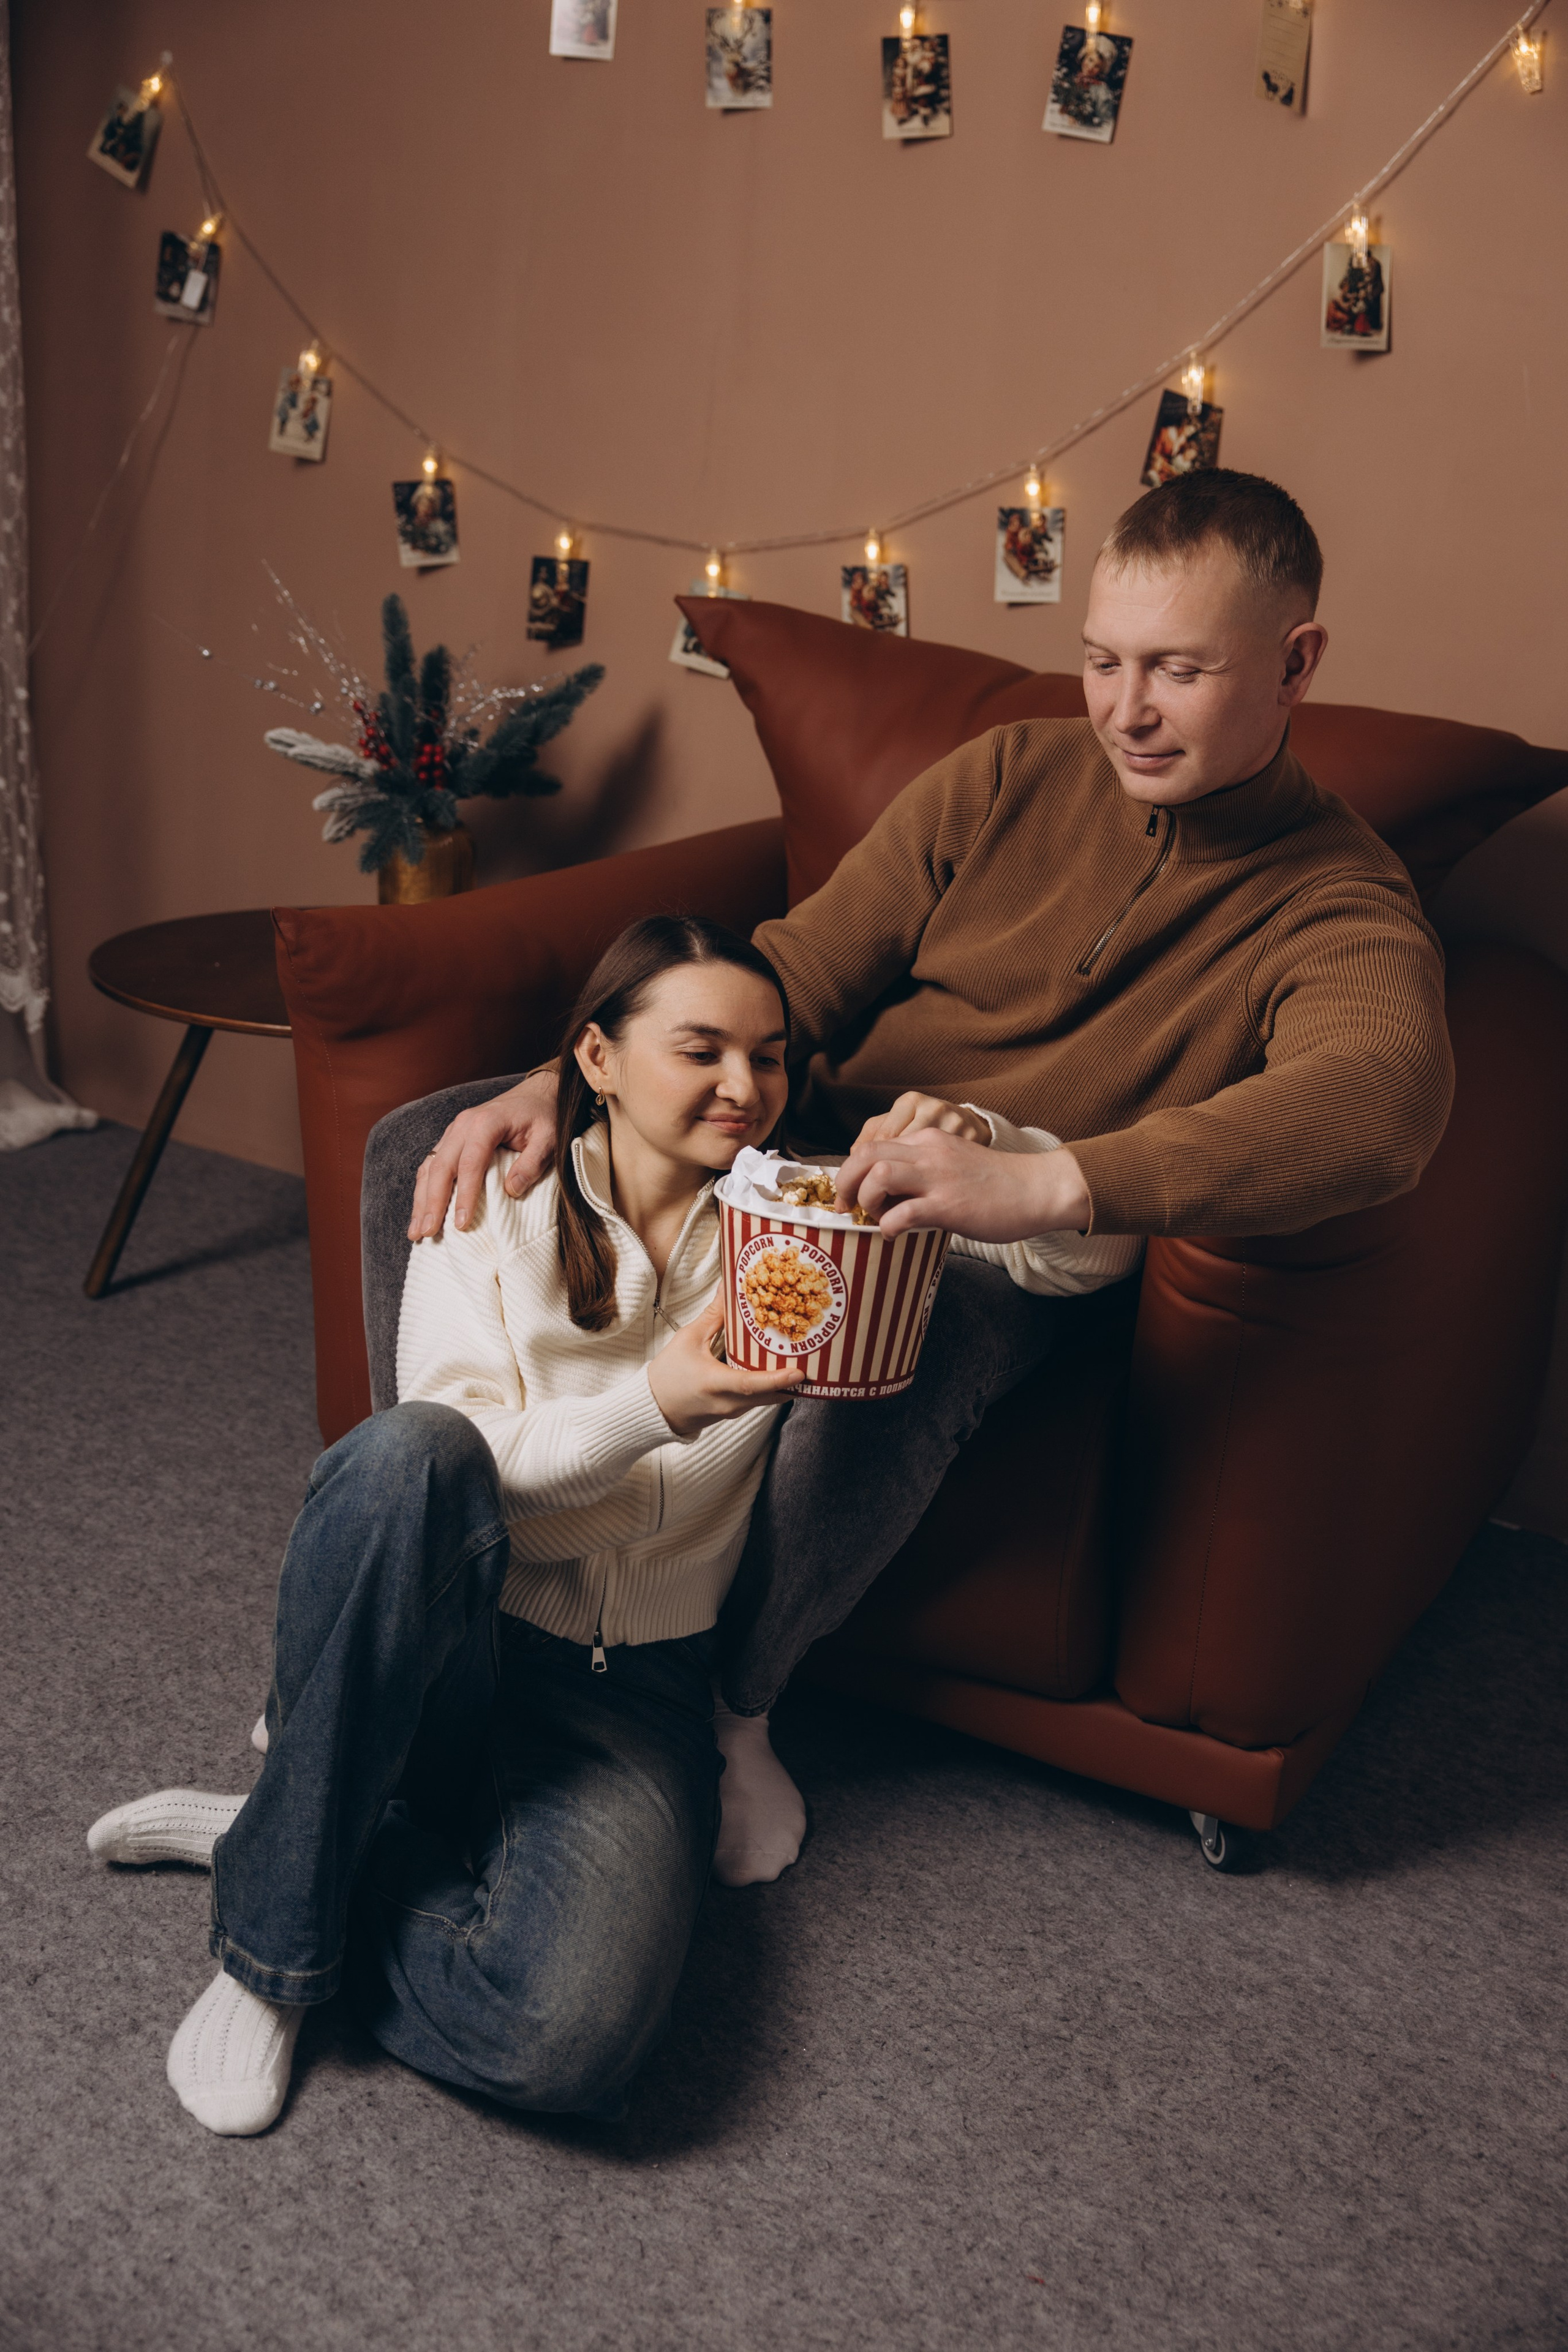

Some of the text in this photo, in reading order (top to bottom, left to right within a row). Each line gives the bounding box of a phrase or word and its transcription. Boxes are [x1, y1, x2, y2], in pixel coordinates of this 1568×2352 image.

[739, 1237, 774, 1273] POPCORN
[801, 1244, 844, 1294] POPCORN
[739, 1292, 772, 1347] POPCORN
[790, 1313, 840, 1353] POPCORN
[785, 1384, 866, 1397] АЧИНАЮТСЯ
[869, 1387, 876, 1396] С
